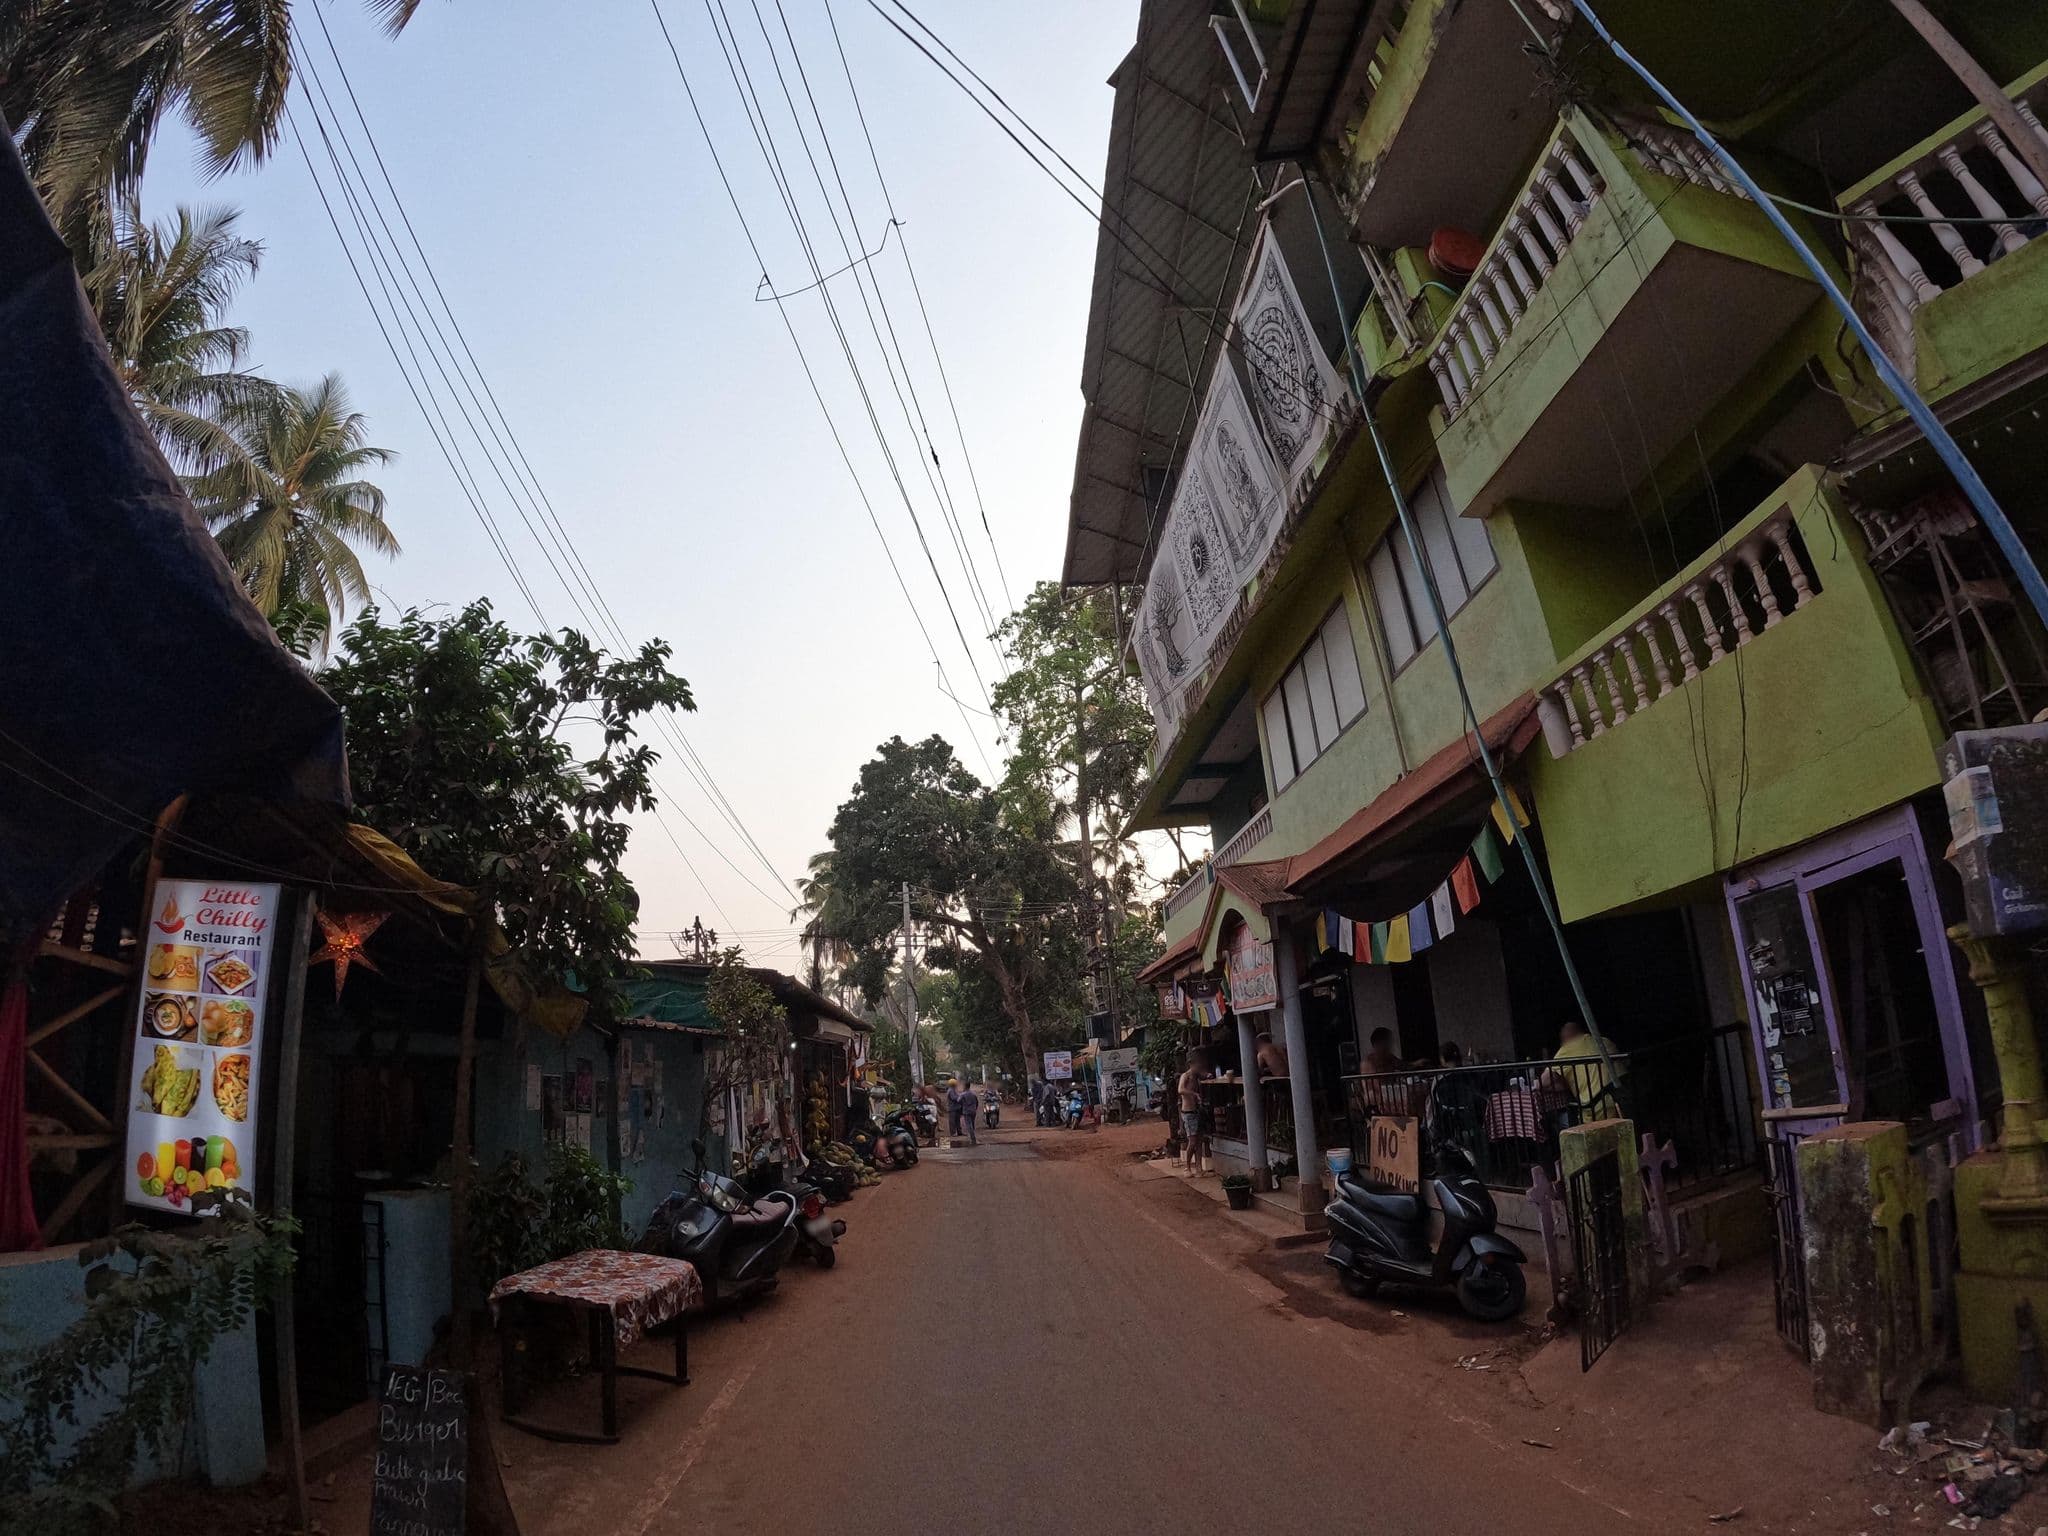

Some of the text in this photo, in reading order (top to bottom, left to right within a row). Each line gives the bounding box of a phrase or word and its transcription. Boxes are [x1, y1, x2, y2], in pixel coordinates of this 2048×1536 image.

[199, 887, 261, 906] Little
[196, 908, 268, 933] Chilly
[183, 930, 261, 946] Restaurant
[1377, 1126, 1398, 1159] NO
